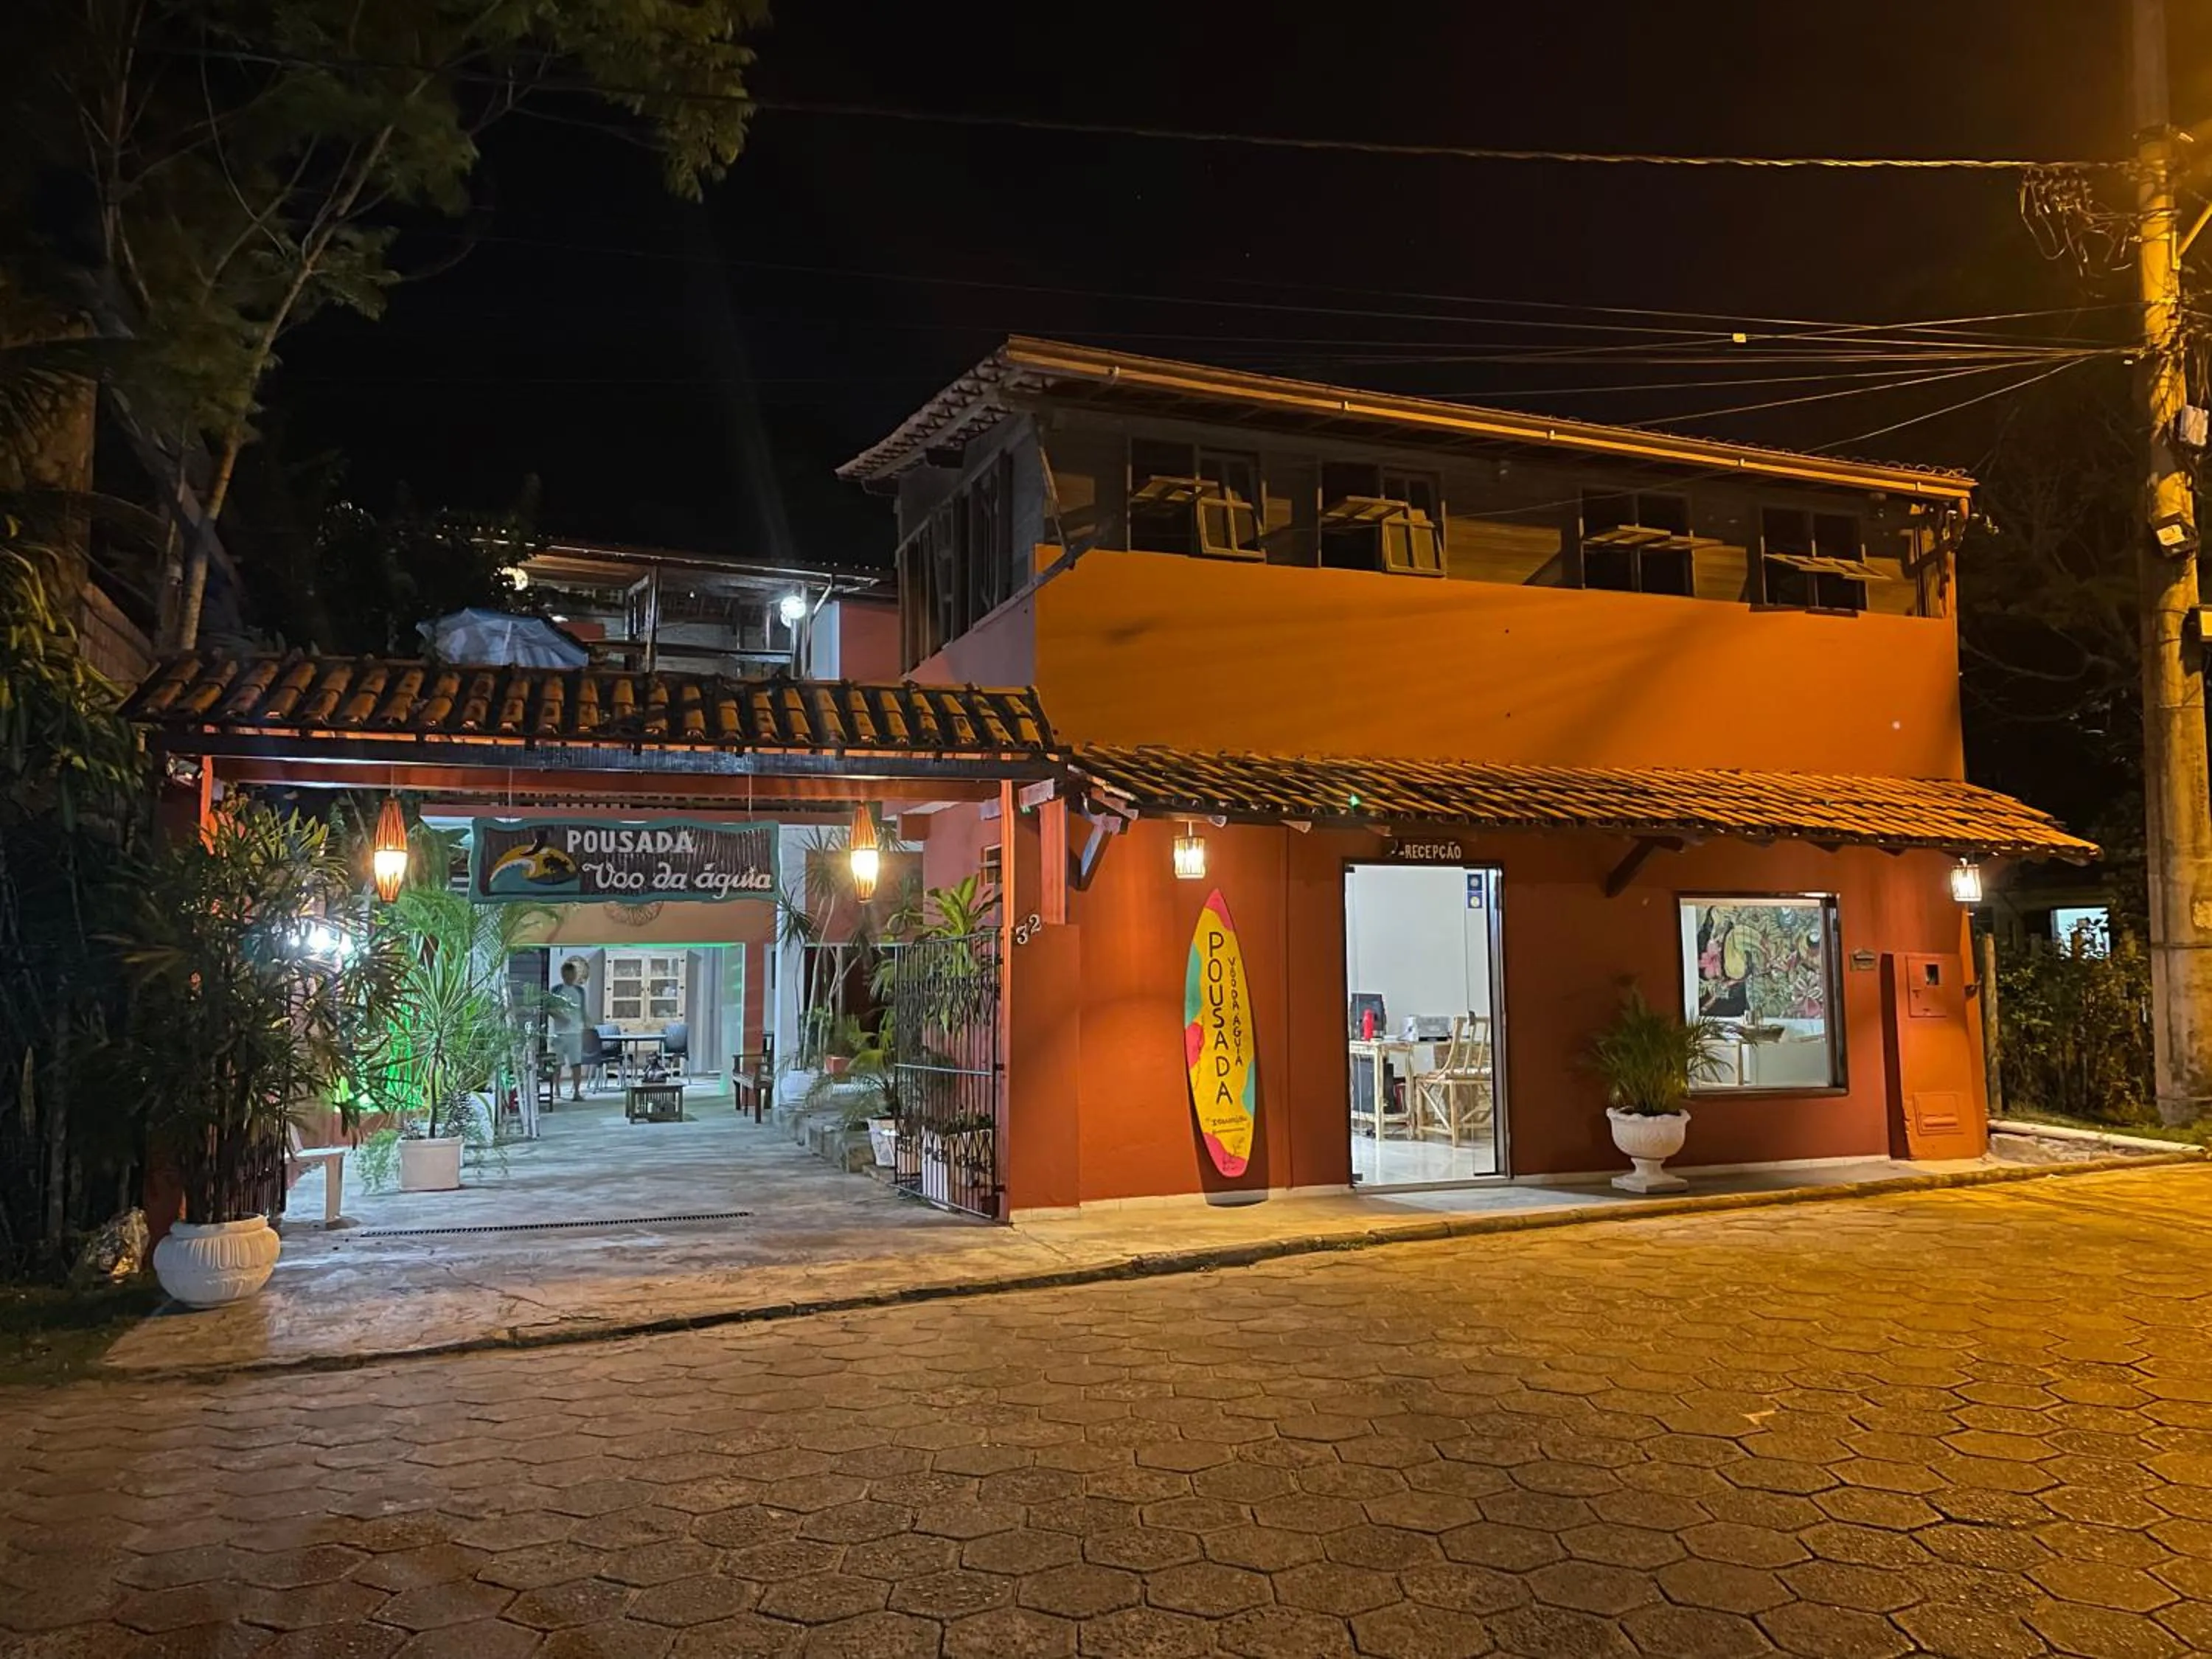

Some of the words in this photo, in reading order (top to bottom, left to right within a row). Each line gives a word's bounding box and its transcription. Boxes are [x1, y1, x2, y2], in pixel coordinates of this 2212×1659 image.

[567, 830, 694, 853] POUSADA
[582, 862, 644, 888] Voo
[653, 861, 687, 888] da
[695, 862, 772, 900] águia
[1016, 914, 1042, 945] 32
[1207, 931, 1233, 1105] POUSADA
